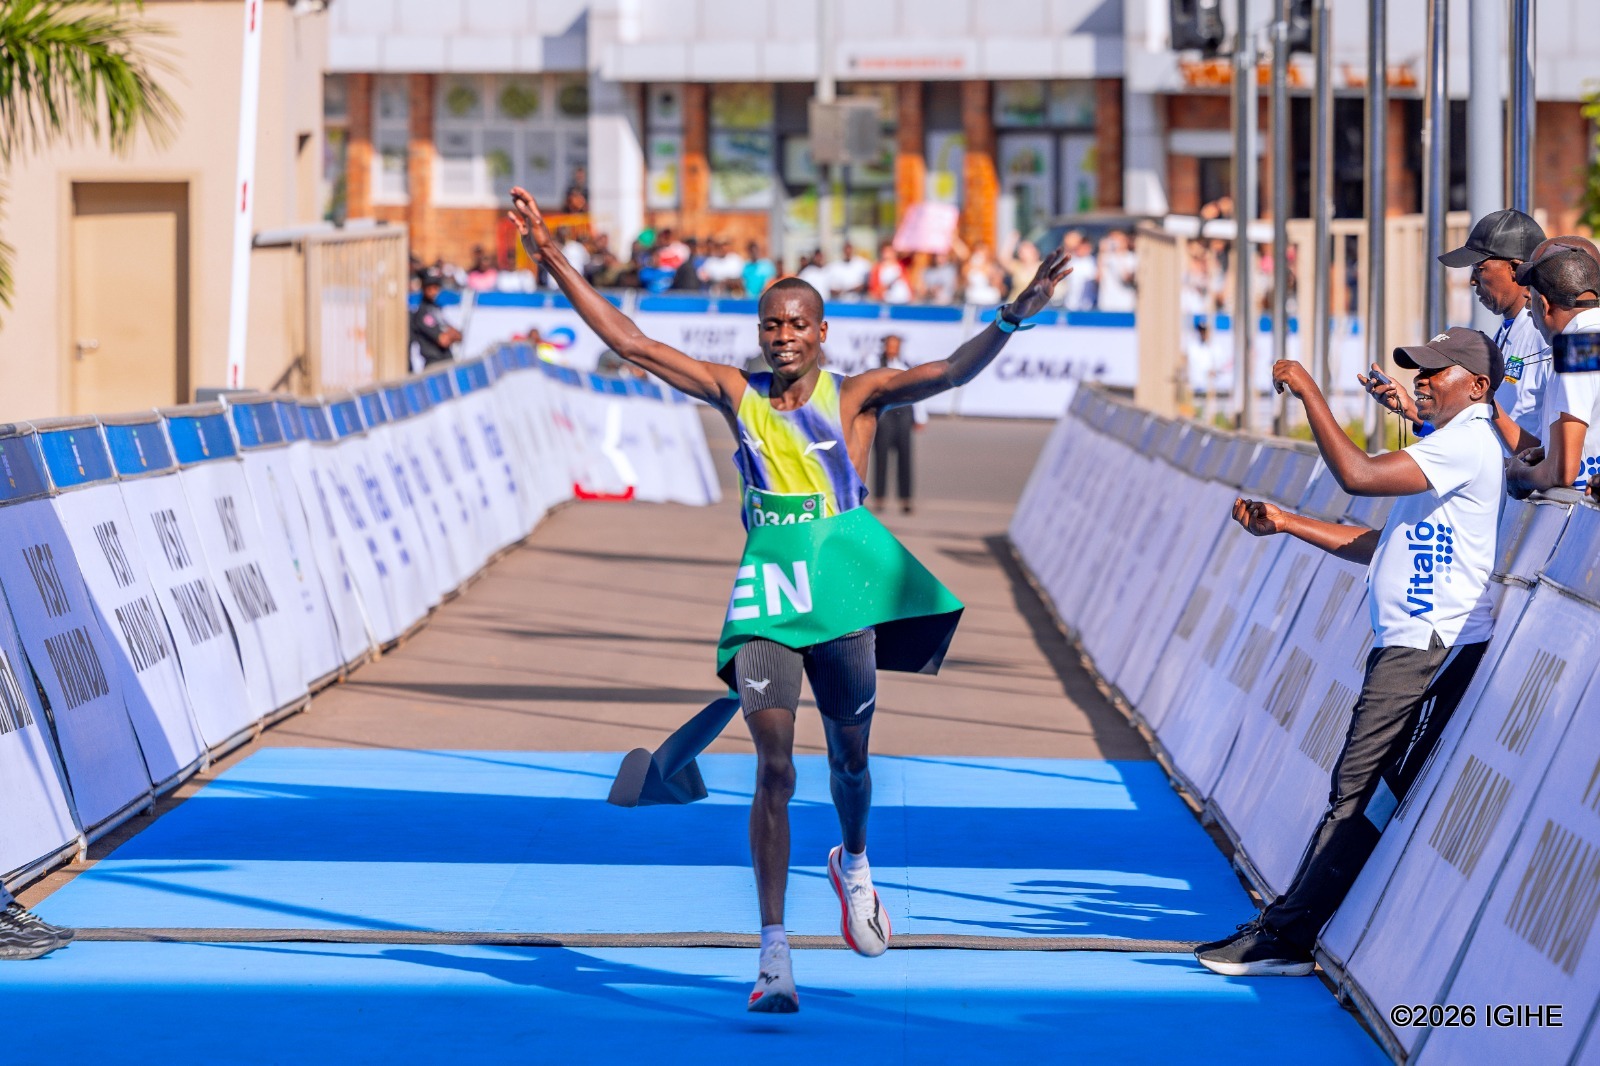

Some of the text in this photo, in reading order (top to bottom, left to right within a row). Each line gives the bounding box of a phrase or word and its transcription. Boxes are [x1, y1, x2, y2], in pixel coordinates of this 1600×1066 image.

[93, 520, 136, 589] VISIT
[150, 509, 193, 572] VISIT
[22, 543, 71, 618] VISIT
[44, 625, 109, 711] RWANDA
[1496, 648, 1566, 756] VISIT
